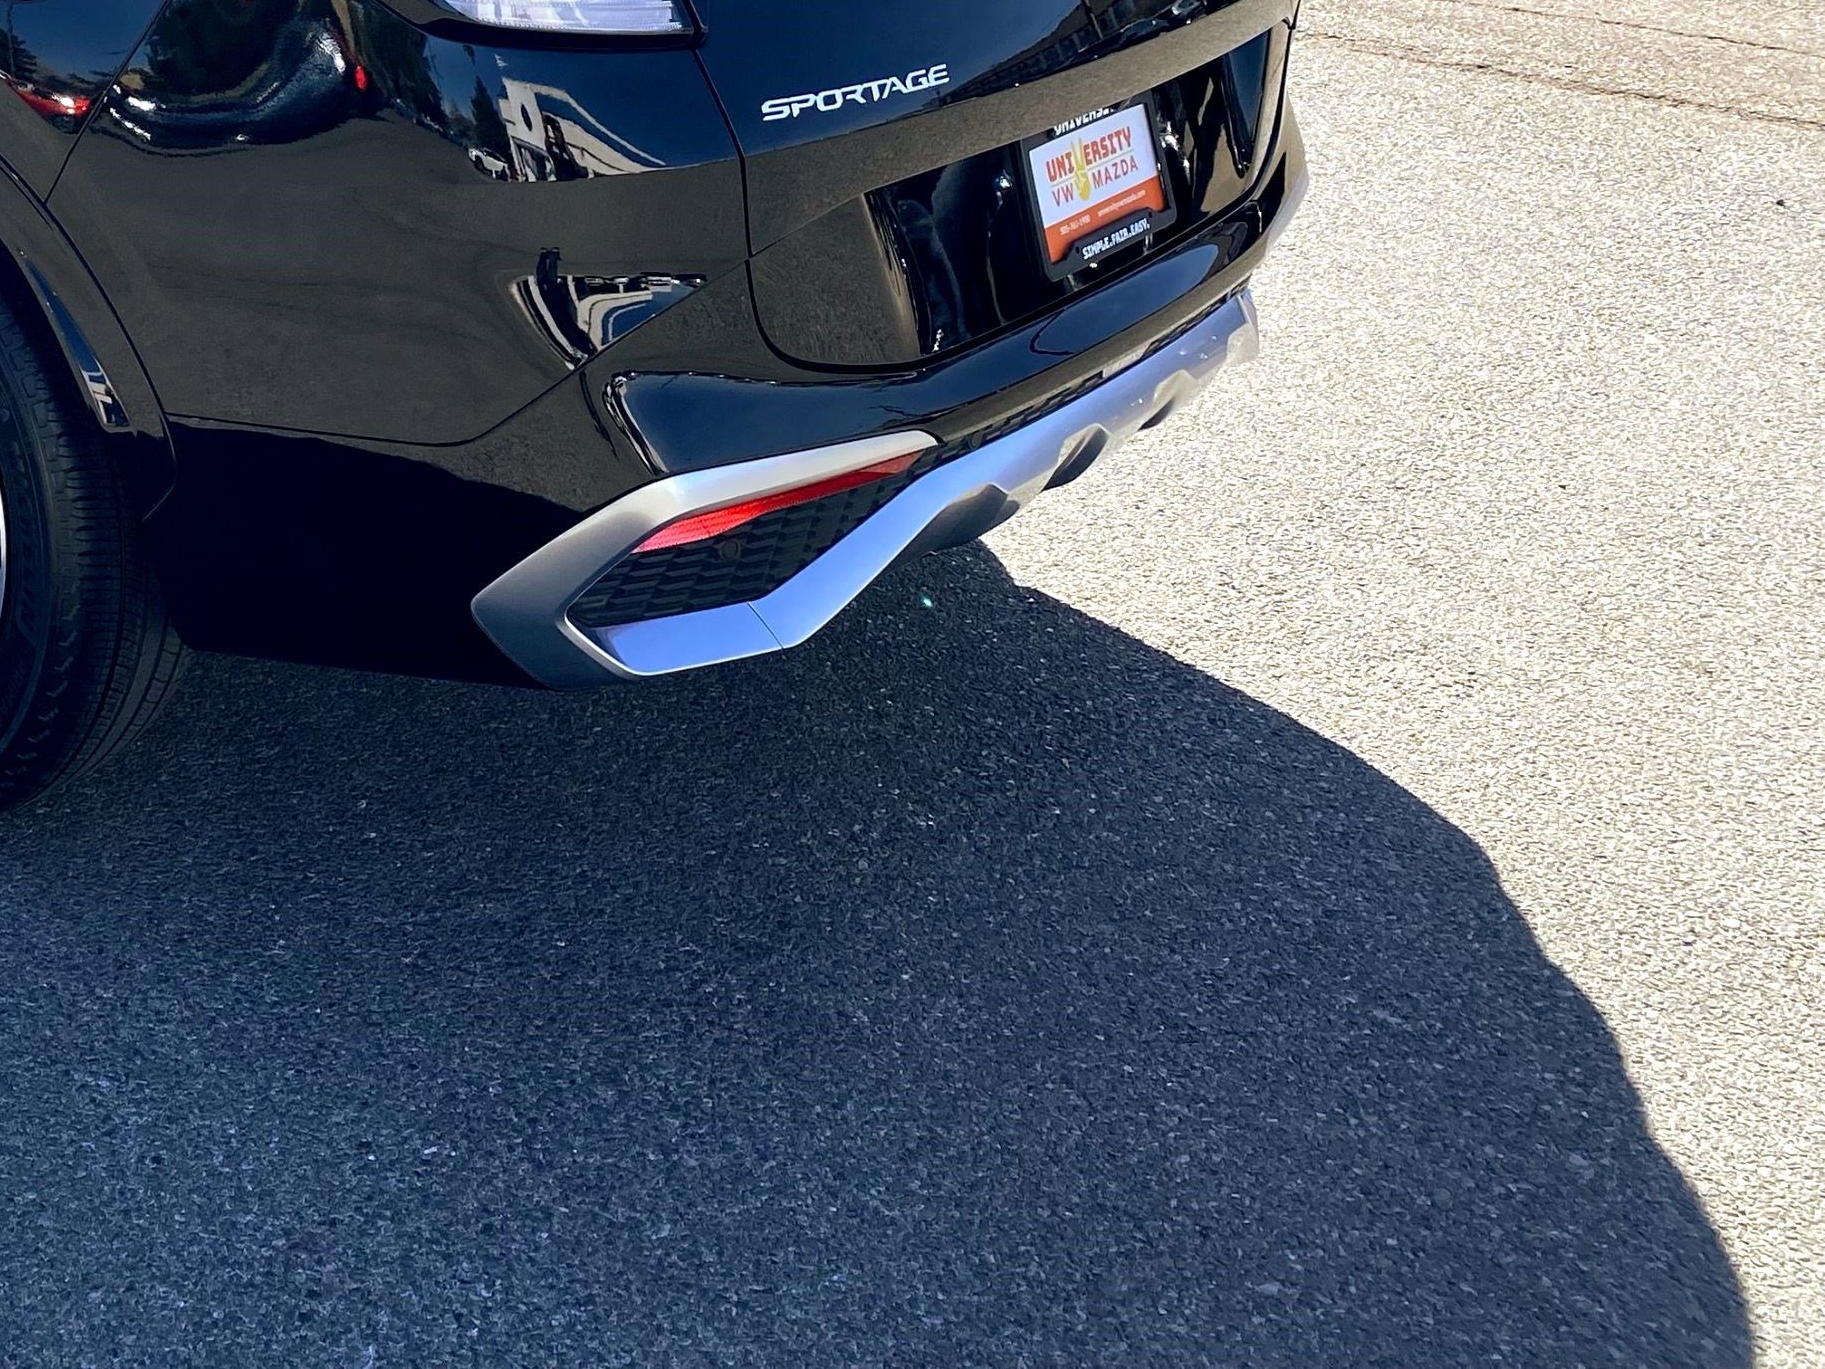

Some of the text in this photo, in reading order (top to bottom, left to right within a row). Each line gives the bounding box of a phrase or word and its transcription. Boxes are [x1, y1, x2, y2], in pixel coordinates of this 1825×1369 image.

[760, 63, 951, 121] SPORTAGE
[1046, 125, 1132, 183] UNIVERSITY
[1052, 154, 1139, 207] VW MAZDA
